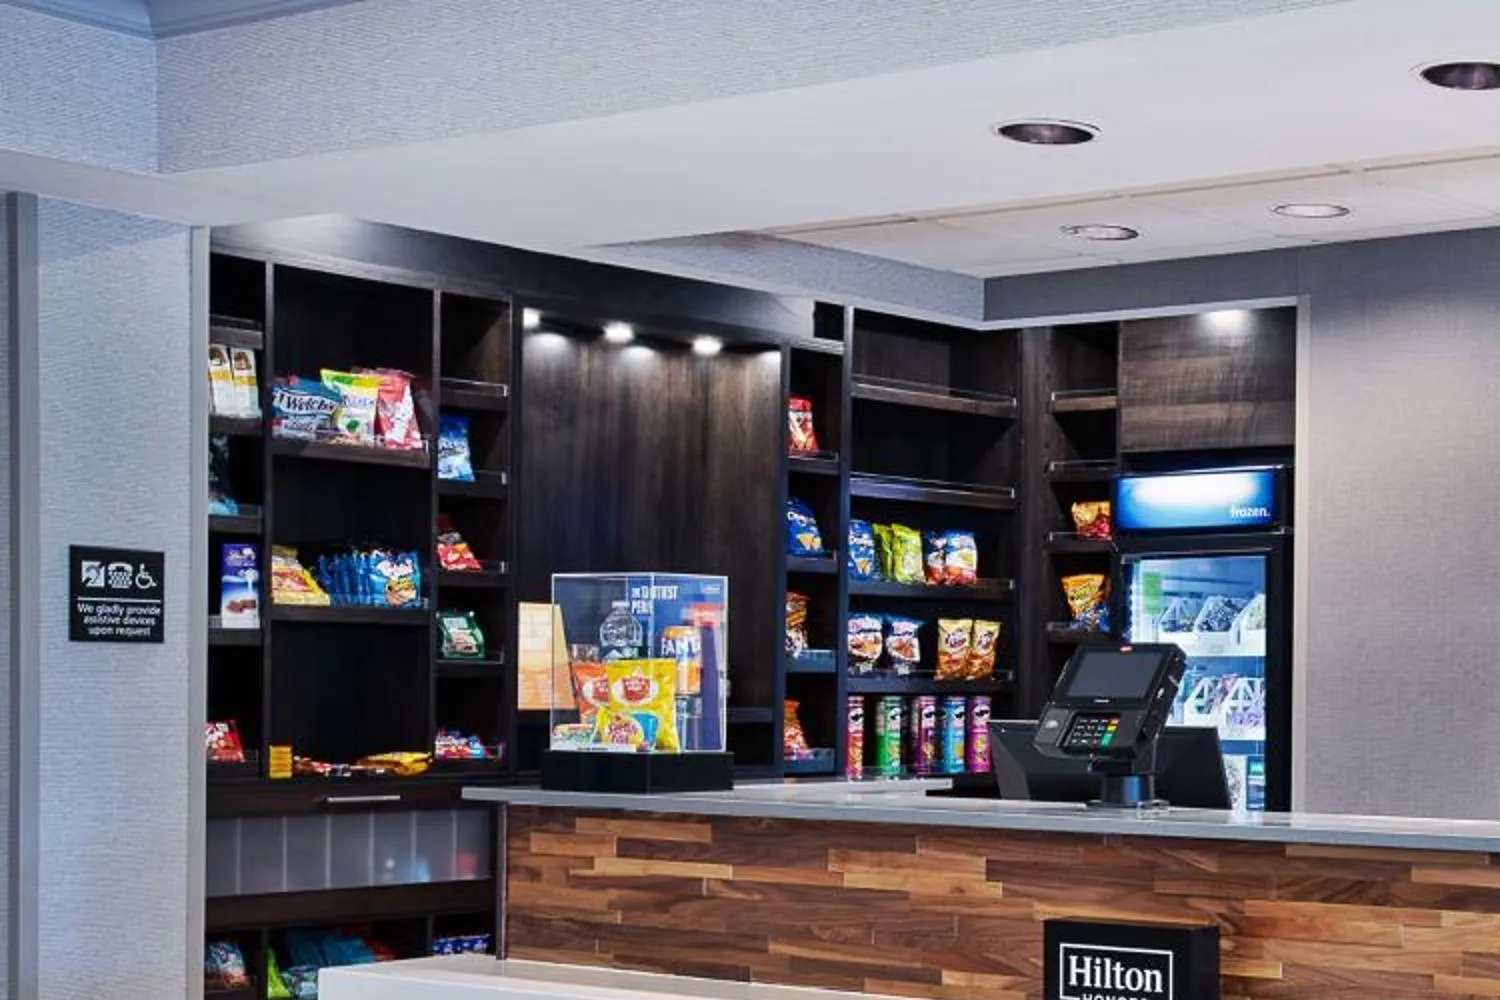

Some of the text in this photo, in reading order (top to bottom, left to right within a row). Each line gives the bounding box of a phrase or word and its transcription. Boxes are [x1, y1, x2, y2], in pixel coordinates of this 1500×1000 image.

[77, 602, 161, 617] We gladly provide
[83, 614, 156, 627] assistive devices
[87, 626, 151, 638] upon request
[1068, 954, 1164, 993] Hilton
